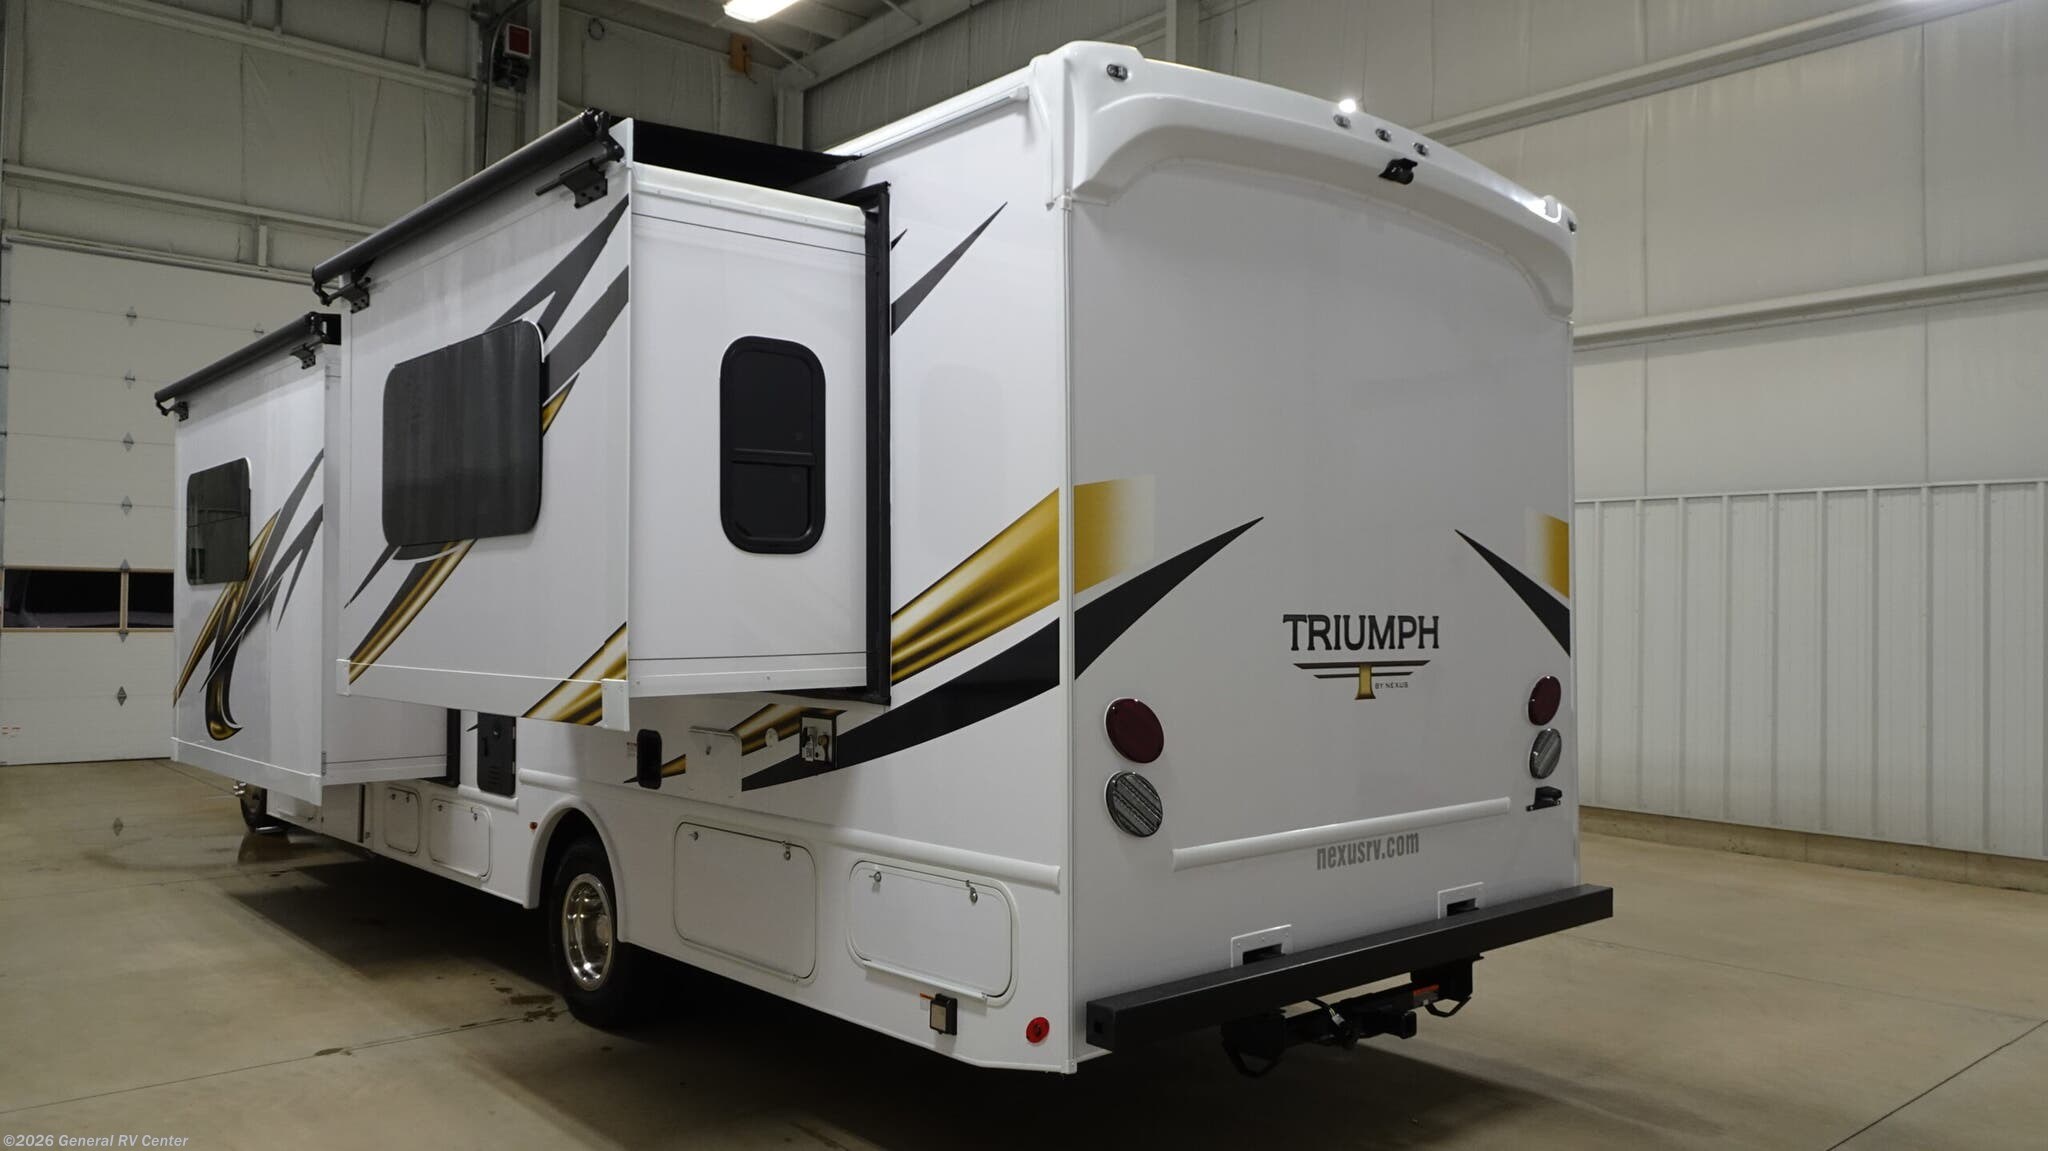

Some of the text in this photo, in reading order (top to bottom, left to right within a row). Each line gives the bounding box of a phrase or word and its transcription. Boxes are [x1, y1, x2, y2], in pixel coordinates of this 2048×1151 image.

[1283, 614, 1440, 651] TRIUMPH
[1385, 681, 1409, 689] NEXUS
[1316, 832, 1420, 871] nexusrv.com
